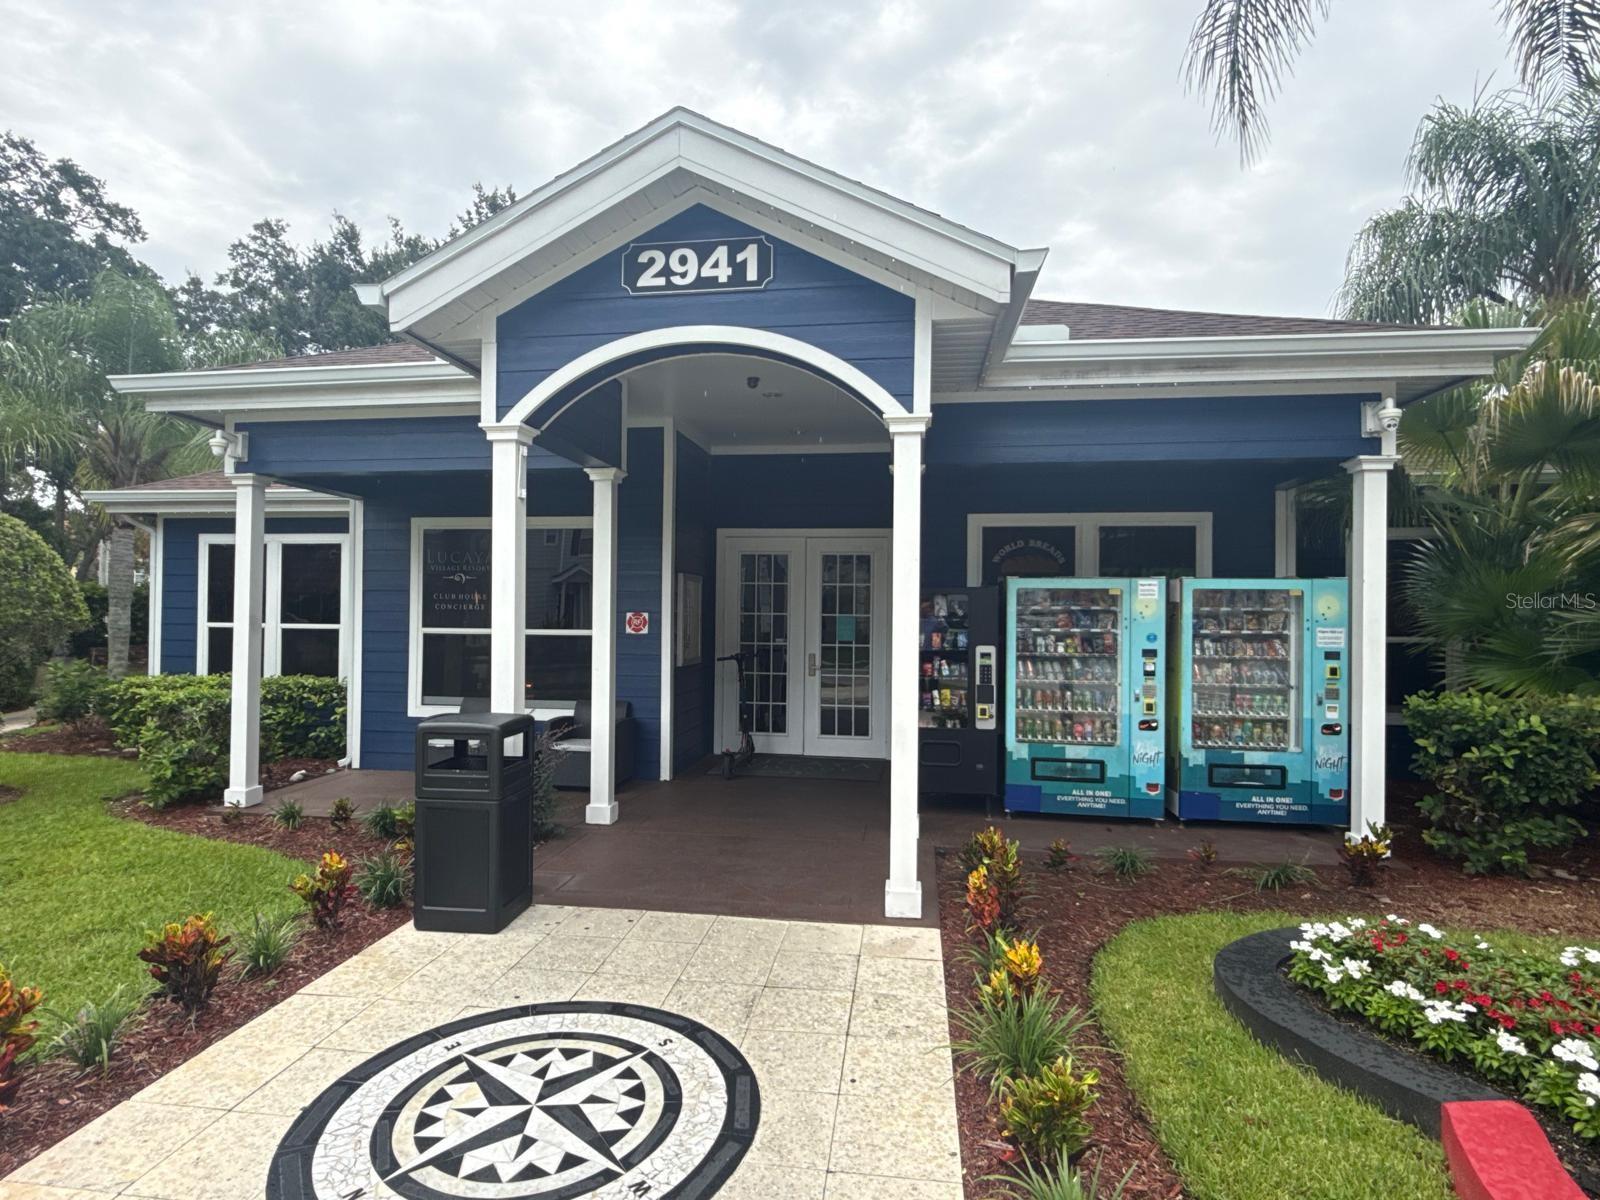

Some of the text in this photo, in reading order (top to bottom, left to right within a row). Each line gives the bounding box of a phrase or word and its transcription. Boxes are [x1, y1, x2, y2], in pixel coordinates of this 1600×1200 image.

[636, 243, 758, 288] 2941
[992, 539, 1066, 564] WORLD BREADS
[1056, 795, 1094, 803] EVERYTHING
[444, 1041, 462, 1052] E
[658, 1038, 673, 1047] S
